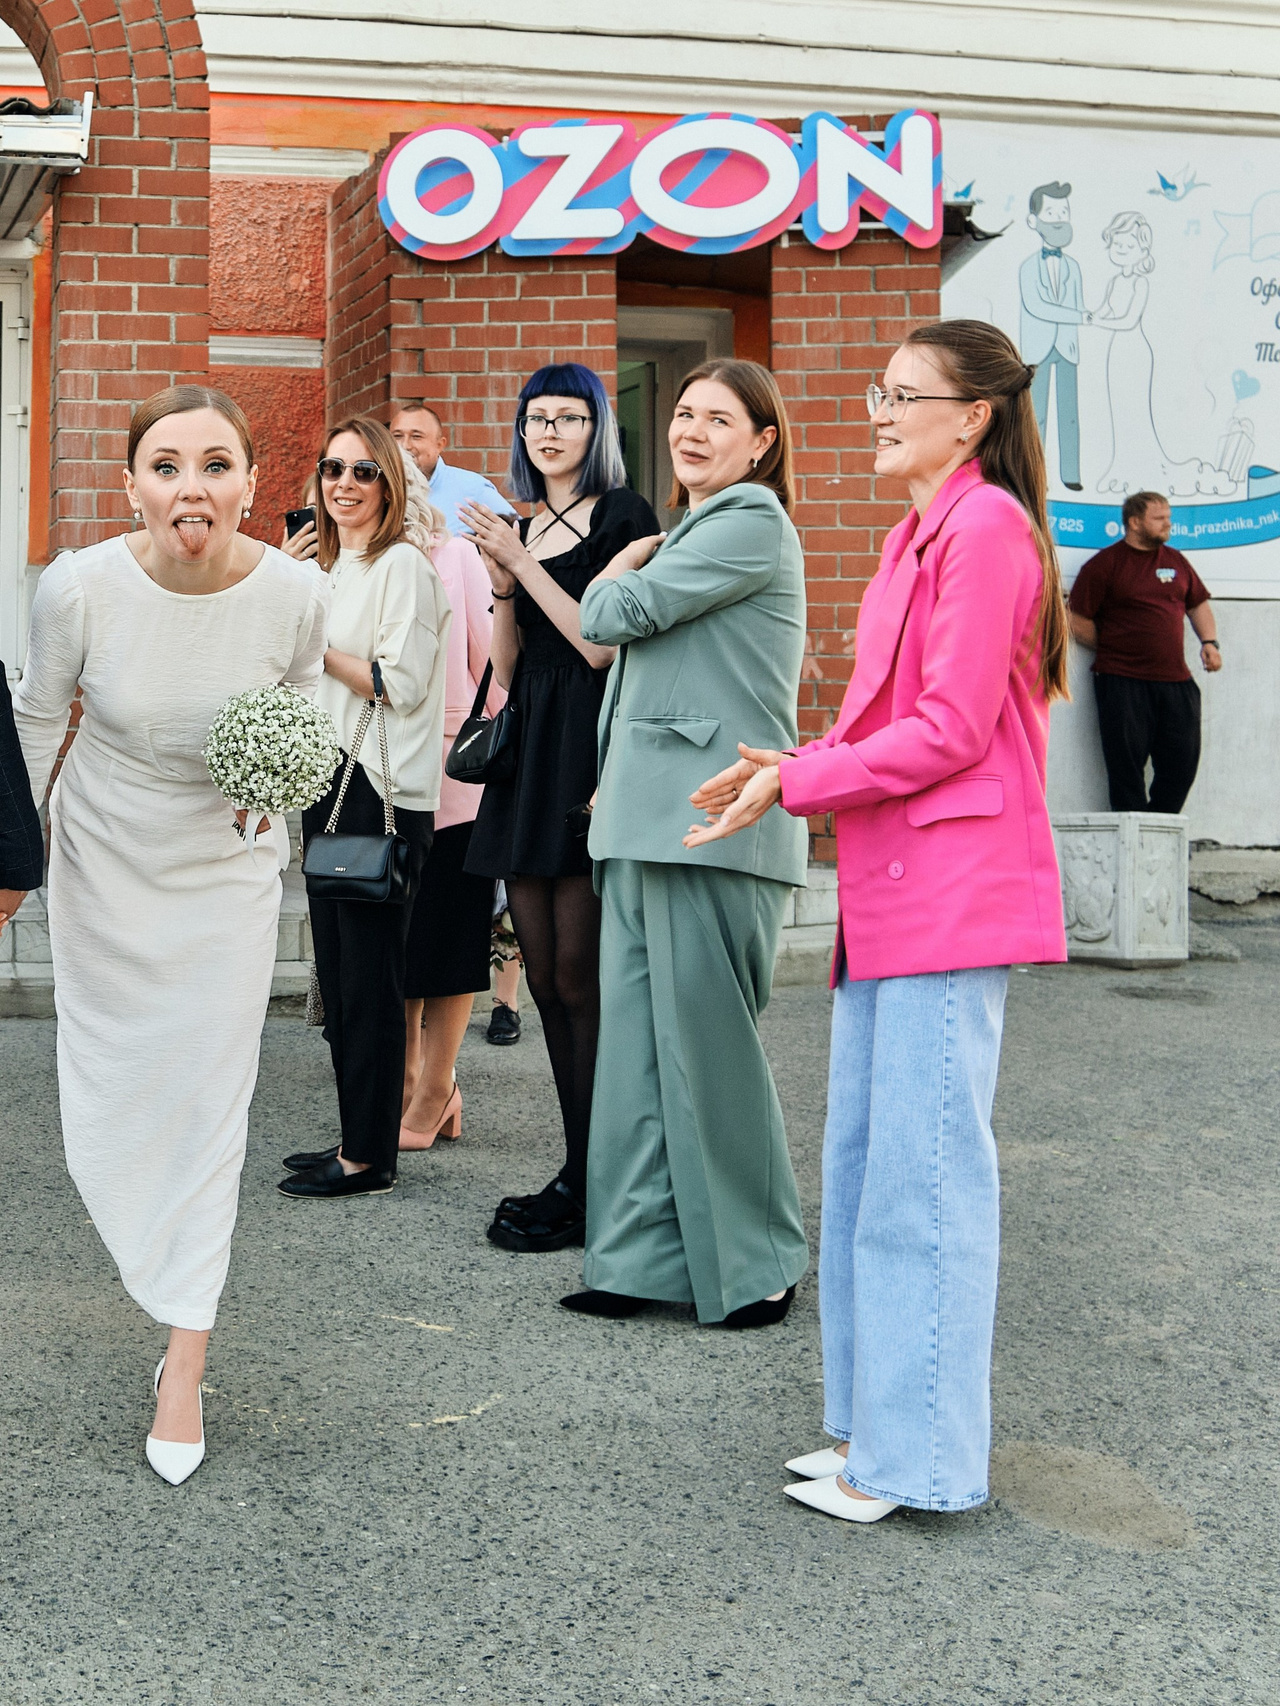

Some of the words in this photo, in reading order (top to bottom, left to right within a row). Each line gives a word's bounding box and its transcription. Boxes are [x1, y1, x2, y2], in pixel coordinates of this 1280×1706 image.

[386, 115, 934, 246] OZON
[1250, 276, 1280, 306] Оф
[1058, 517, 1084, 533] 825
[1170, 509, 1280, 538] dia_prazdnika_nsk
